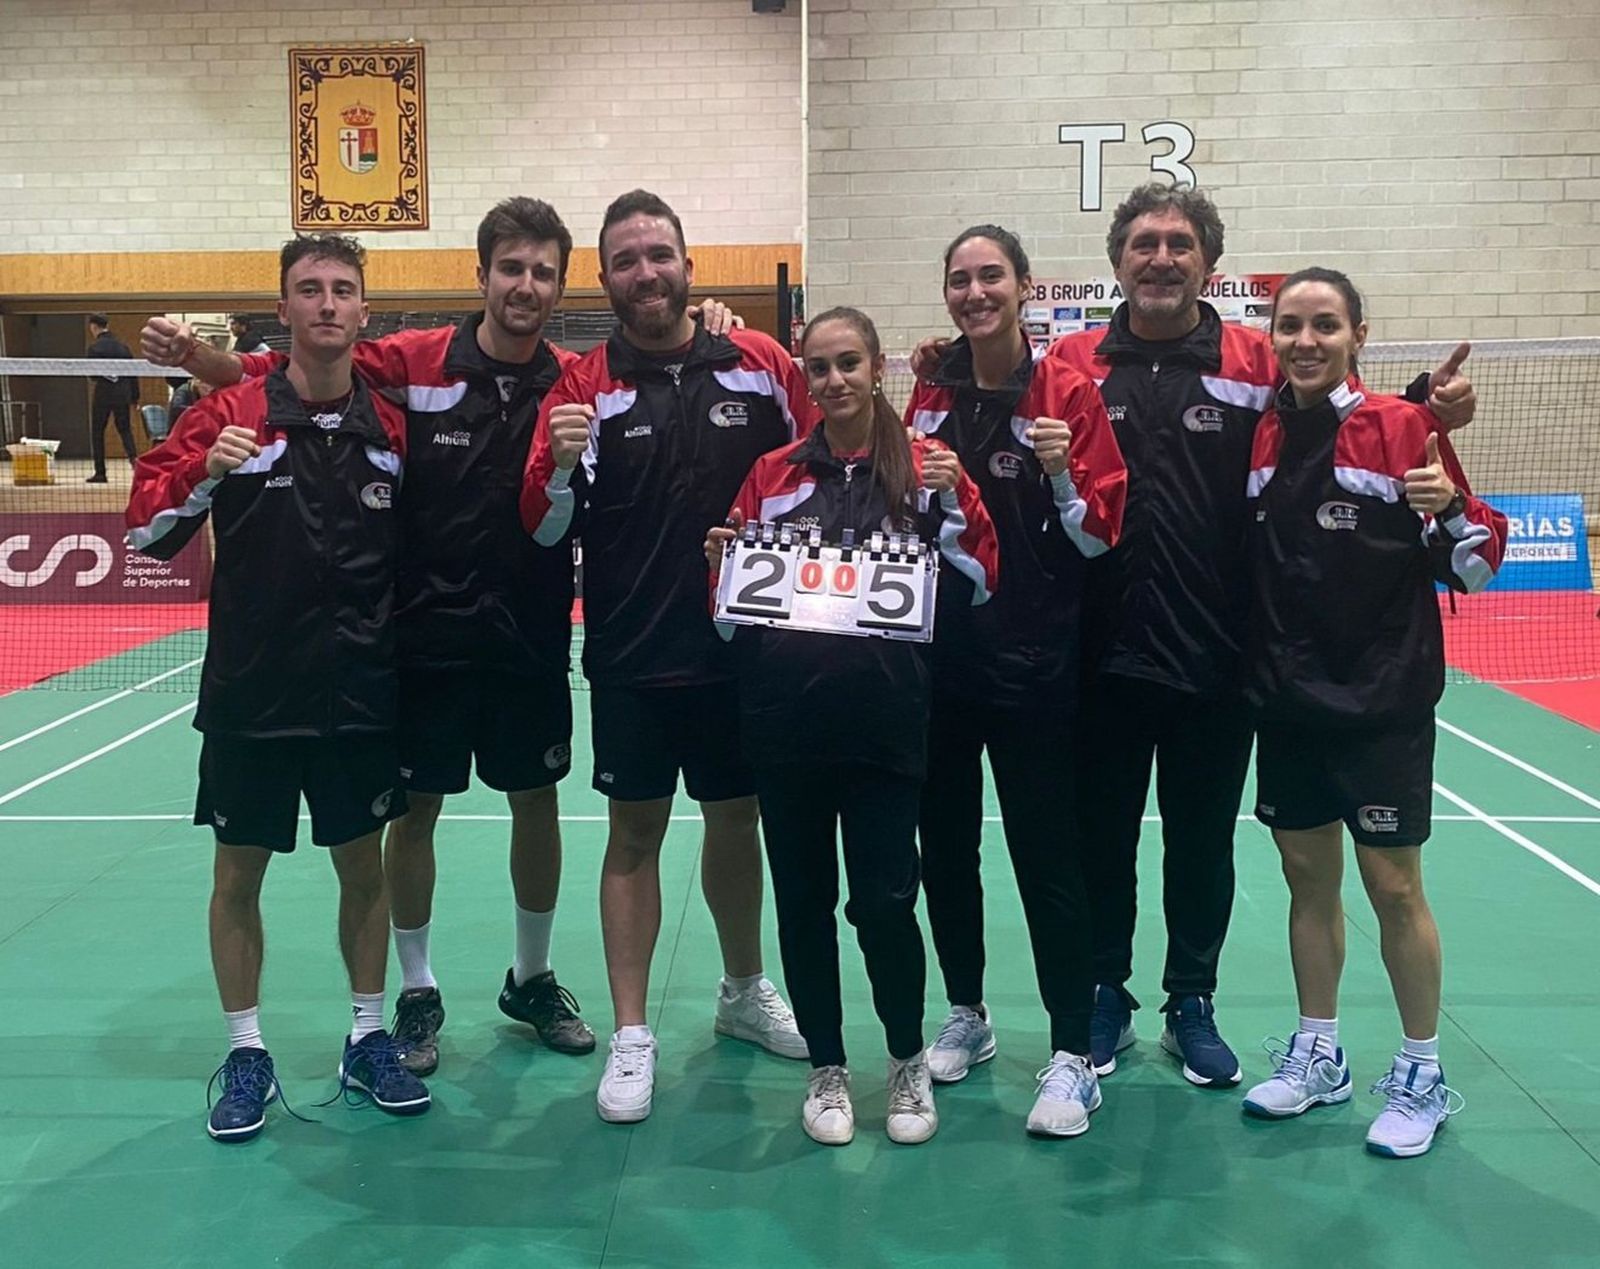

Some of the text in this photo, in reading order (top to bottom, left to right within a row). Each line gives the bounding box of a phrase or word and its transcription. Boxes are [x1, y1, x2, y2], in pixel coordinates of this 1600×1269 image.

[1051, 284, 1105, 301] GRUPO
[1508, 512, 1575, 538] RÍAS
[124, 565, 172, 577] Superior
[122, 577, 191, 589] de Deportes
[736, 552, 786, 608] 2
[867, 563, 916, 620] 5
